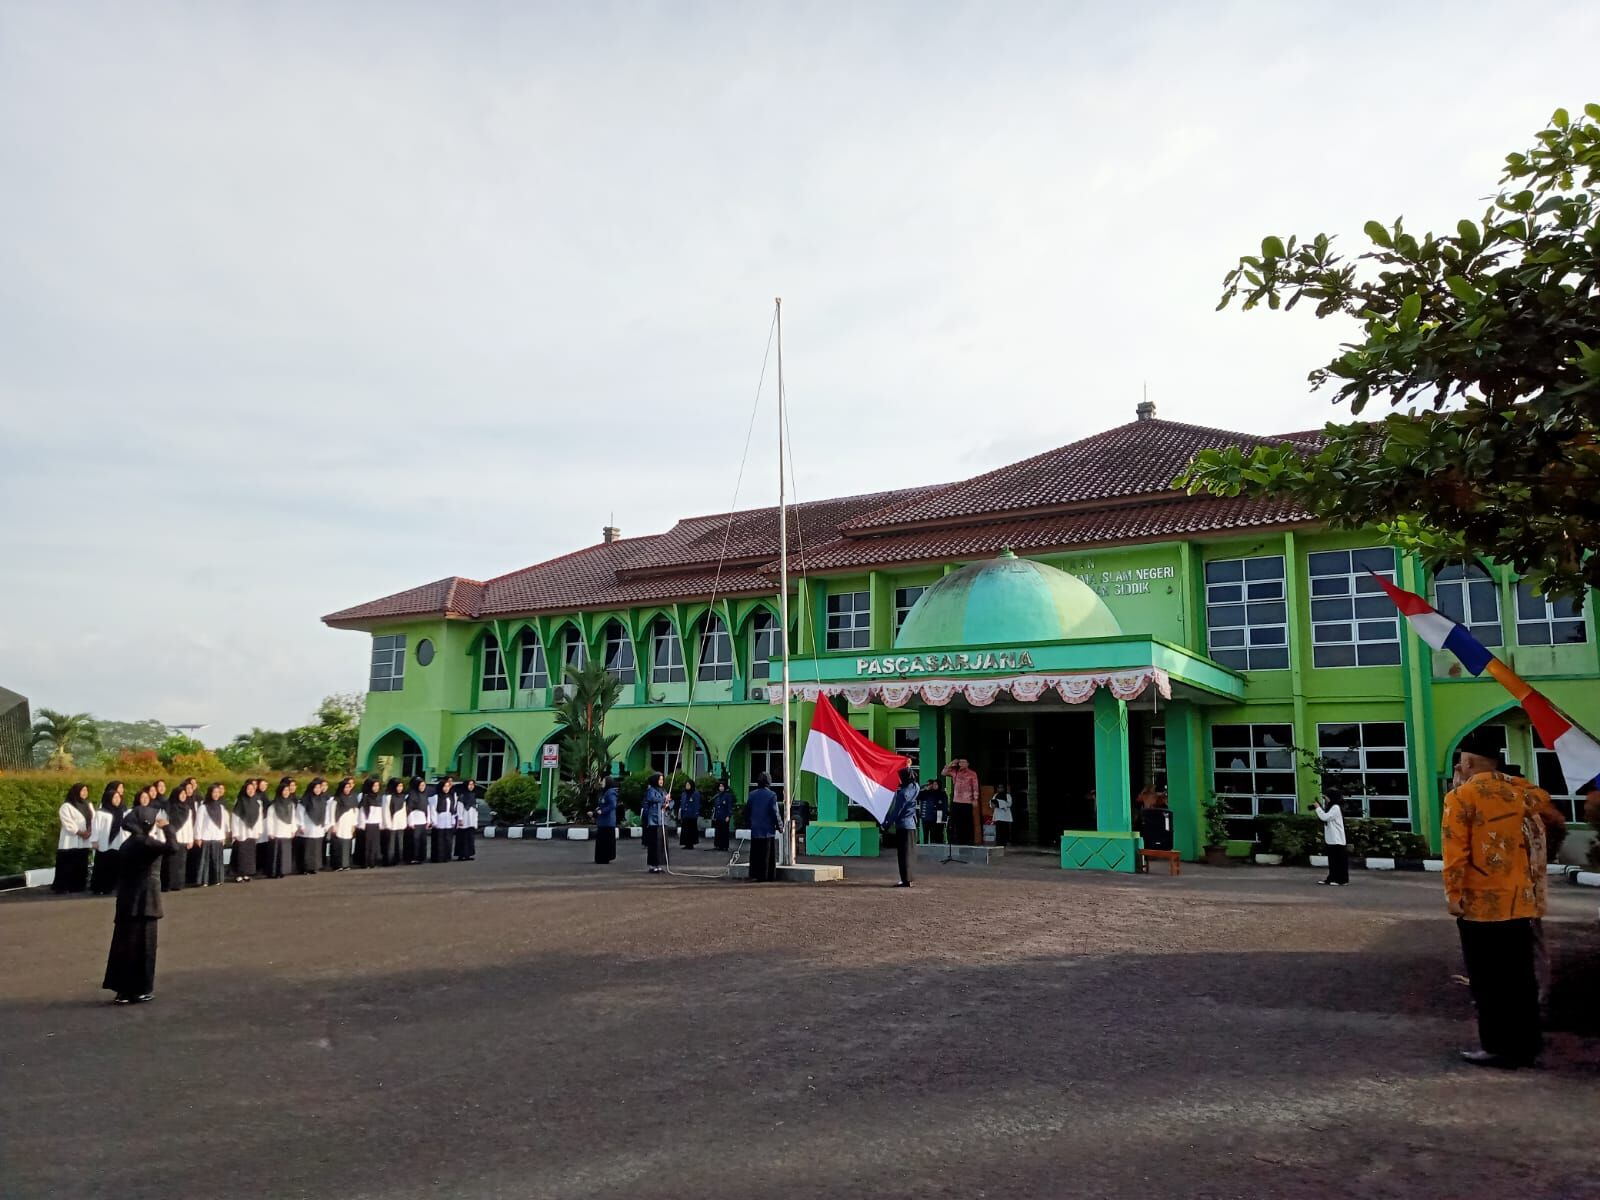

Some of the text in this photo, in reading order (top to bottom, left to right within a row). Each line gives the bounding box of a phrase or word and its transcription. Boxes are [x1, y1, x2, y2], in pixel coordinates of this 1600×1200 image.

[1136, 566, 1174, 580] NEGERI
[1114, 582, 1150, 596] SIDDIK
[856, 650, 1035, 676] PASCASARJANA
